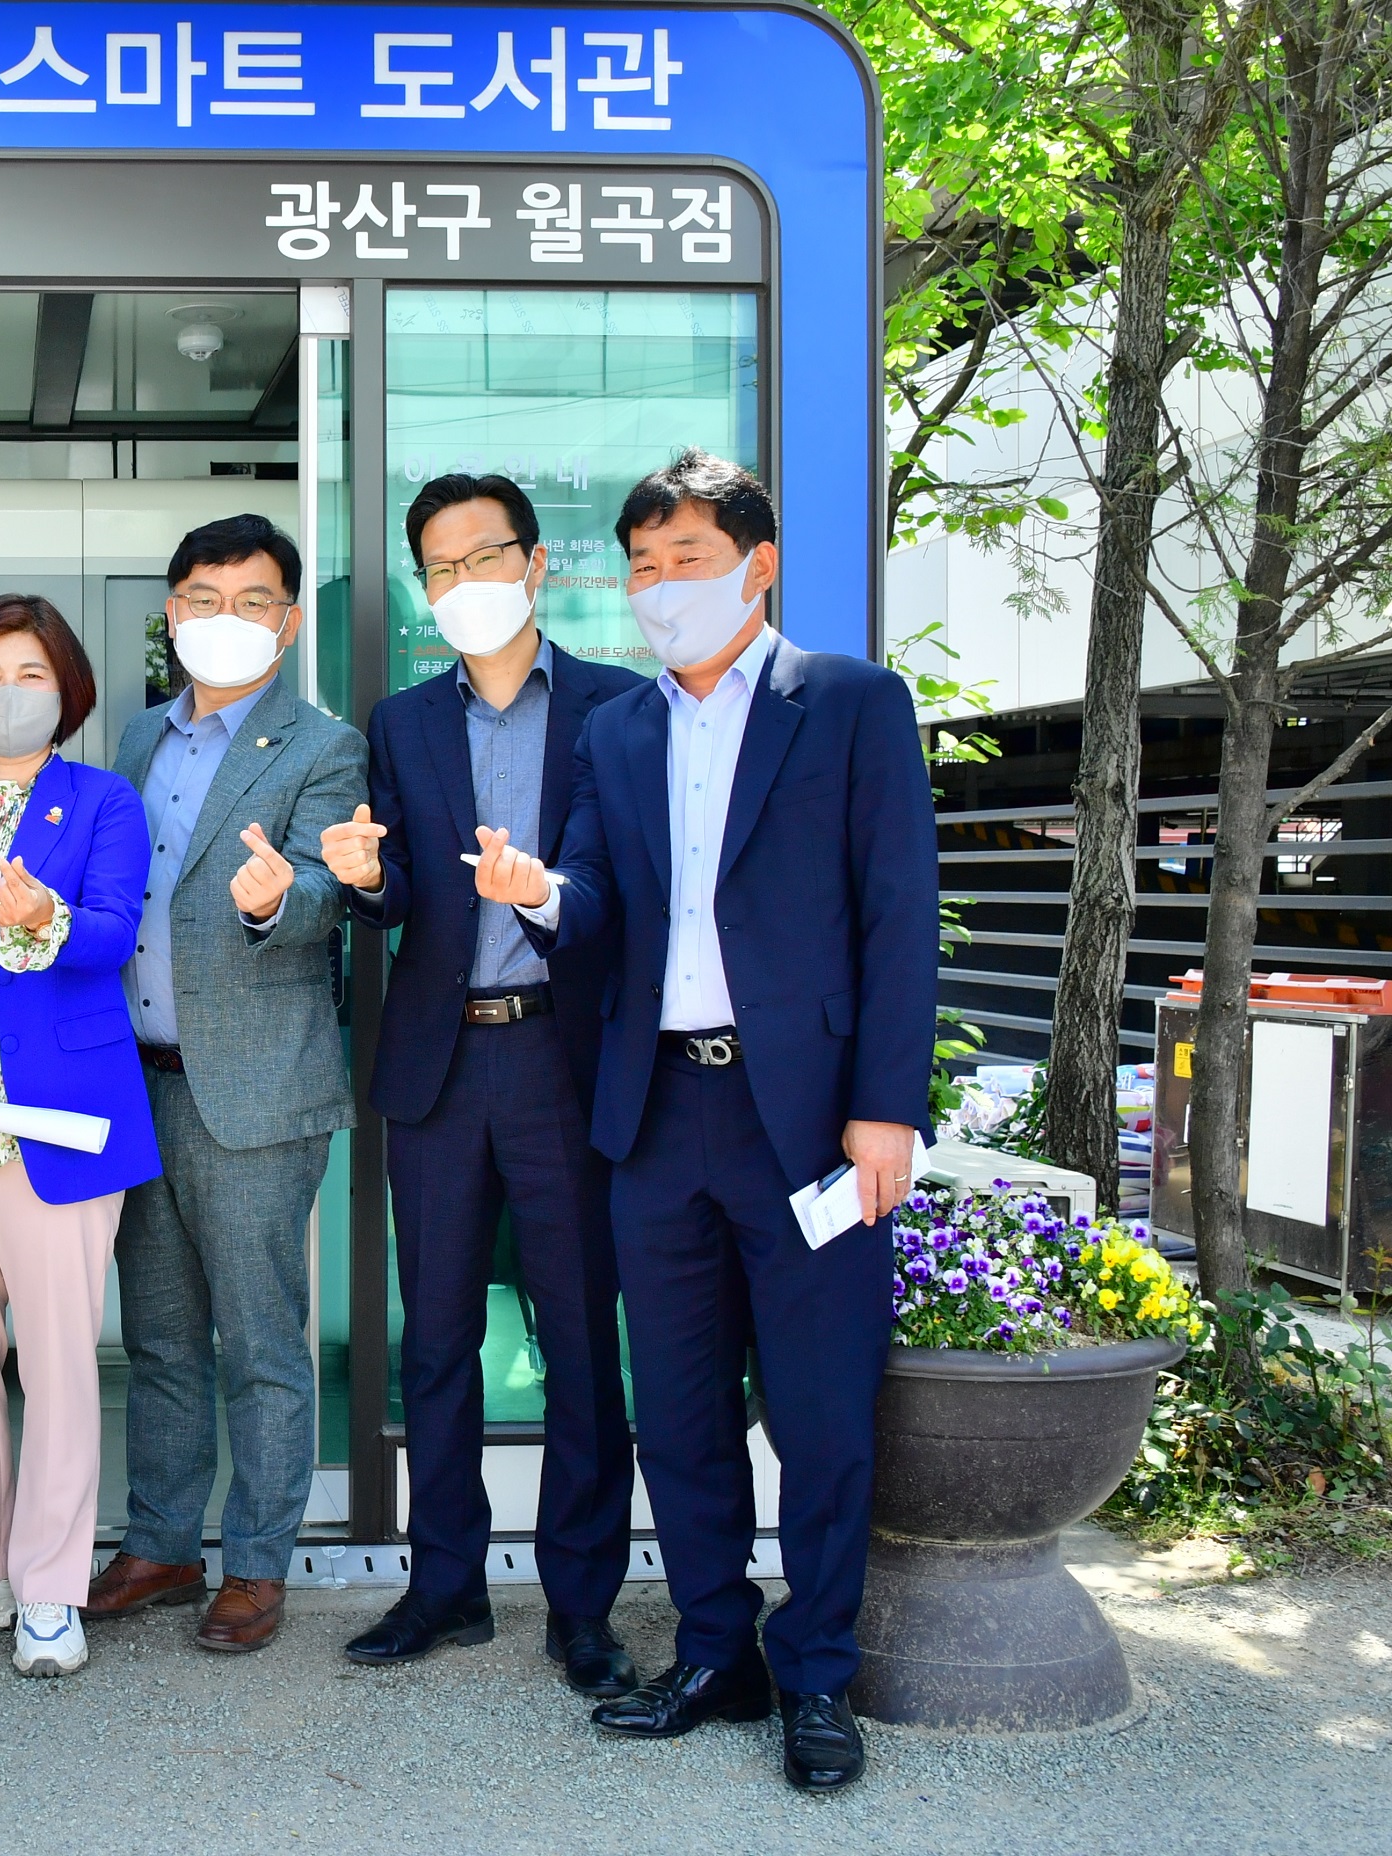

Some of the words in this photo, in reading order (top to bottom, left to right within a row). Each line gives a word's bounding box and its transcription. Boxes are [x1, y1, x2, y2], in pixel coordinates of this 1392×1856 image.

[360, 26, 684, 132] 도서관
[264, 180, 492, 262] 광산구
[516, 182, 734, 264] 월곡점
[569, 539, 606, 553] 회원증
[548, 576, 618, 589] 연체기간만큼
